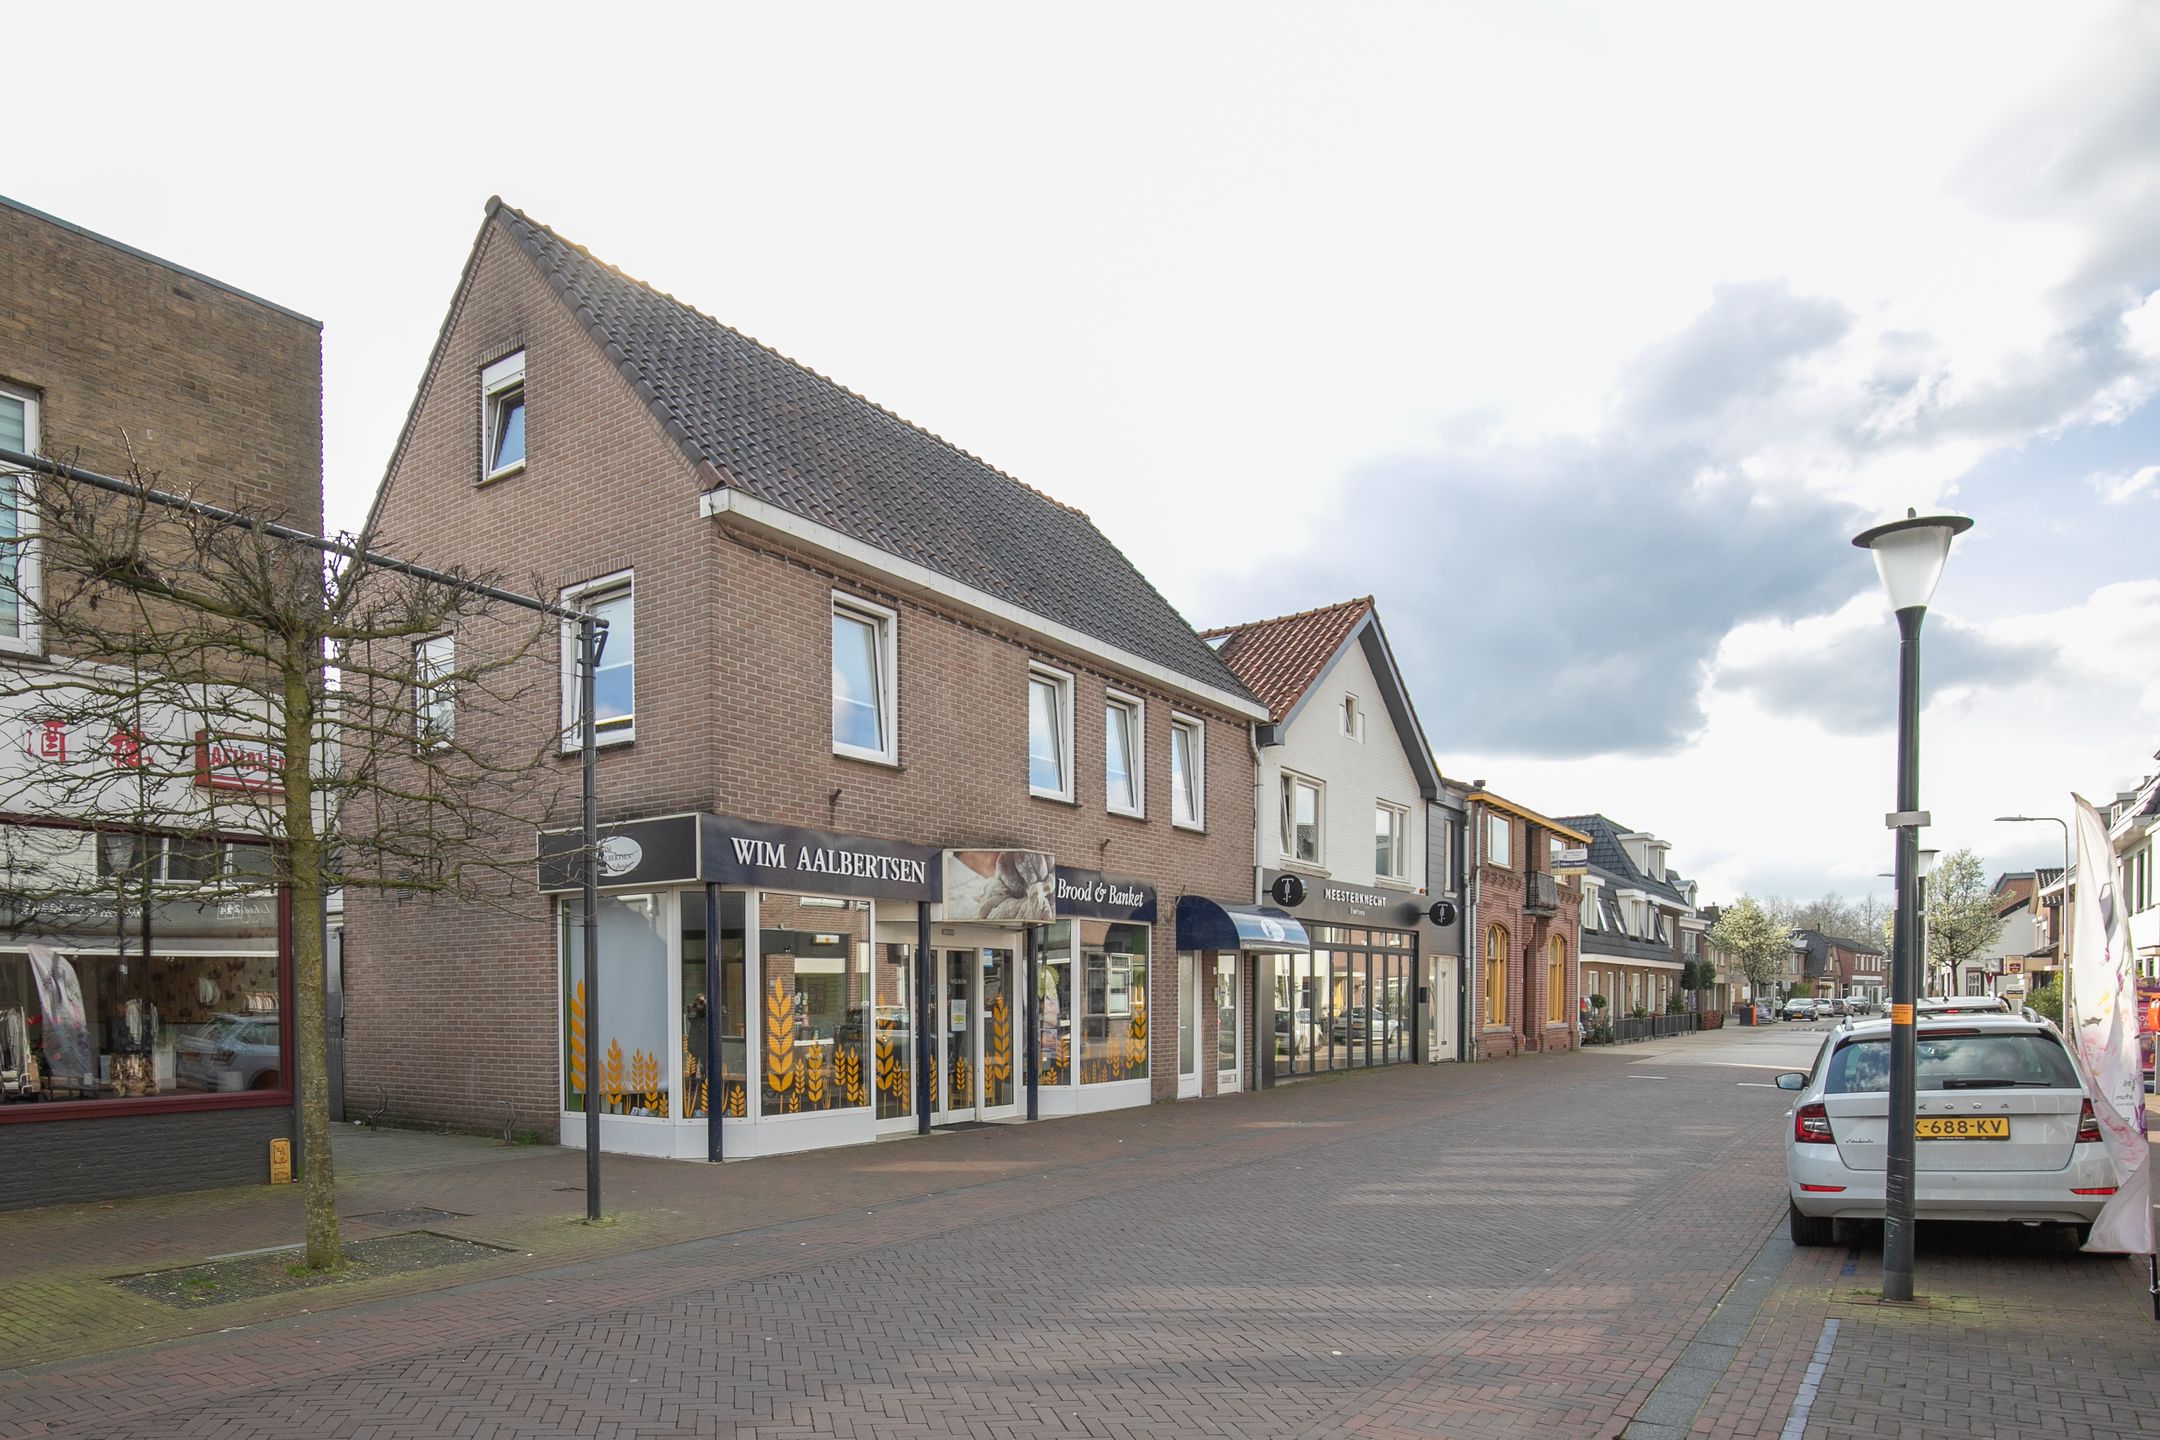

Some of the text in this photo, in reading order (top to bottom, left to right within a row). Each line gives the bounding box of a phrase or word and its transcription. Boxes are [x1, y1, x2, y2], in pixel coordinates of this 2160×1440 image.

[730, 837, 926, 884] WIM AALBERTSEN
[1057, 878, 1144, 907] Brood & Banket
[1324, 887, 1387, 908] MEESTERKNECHT
